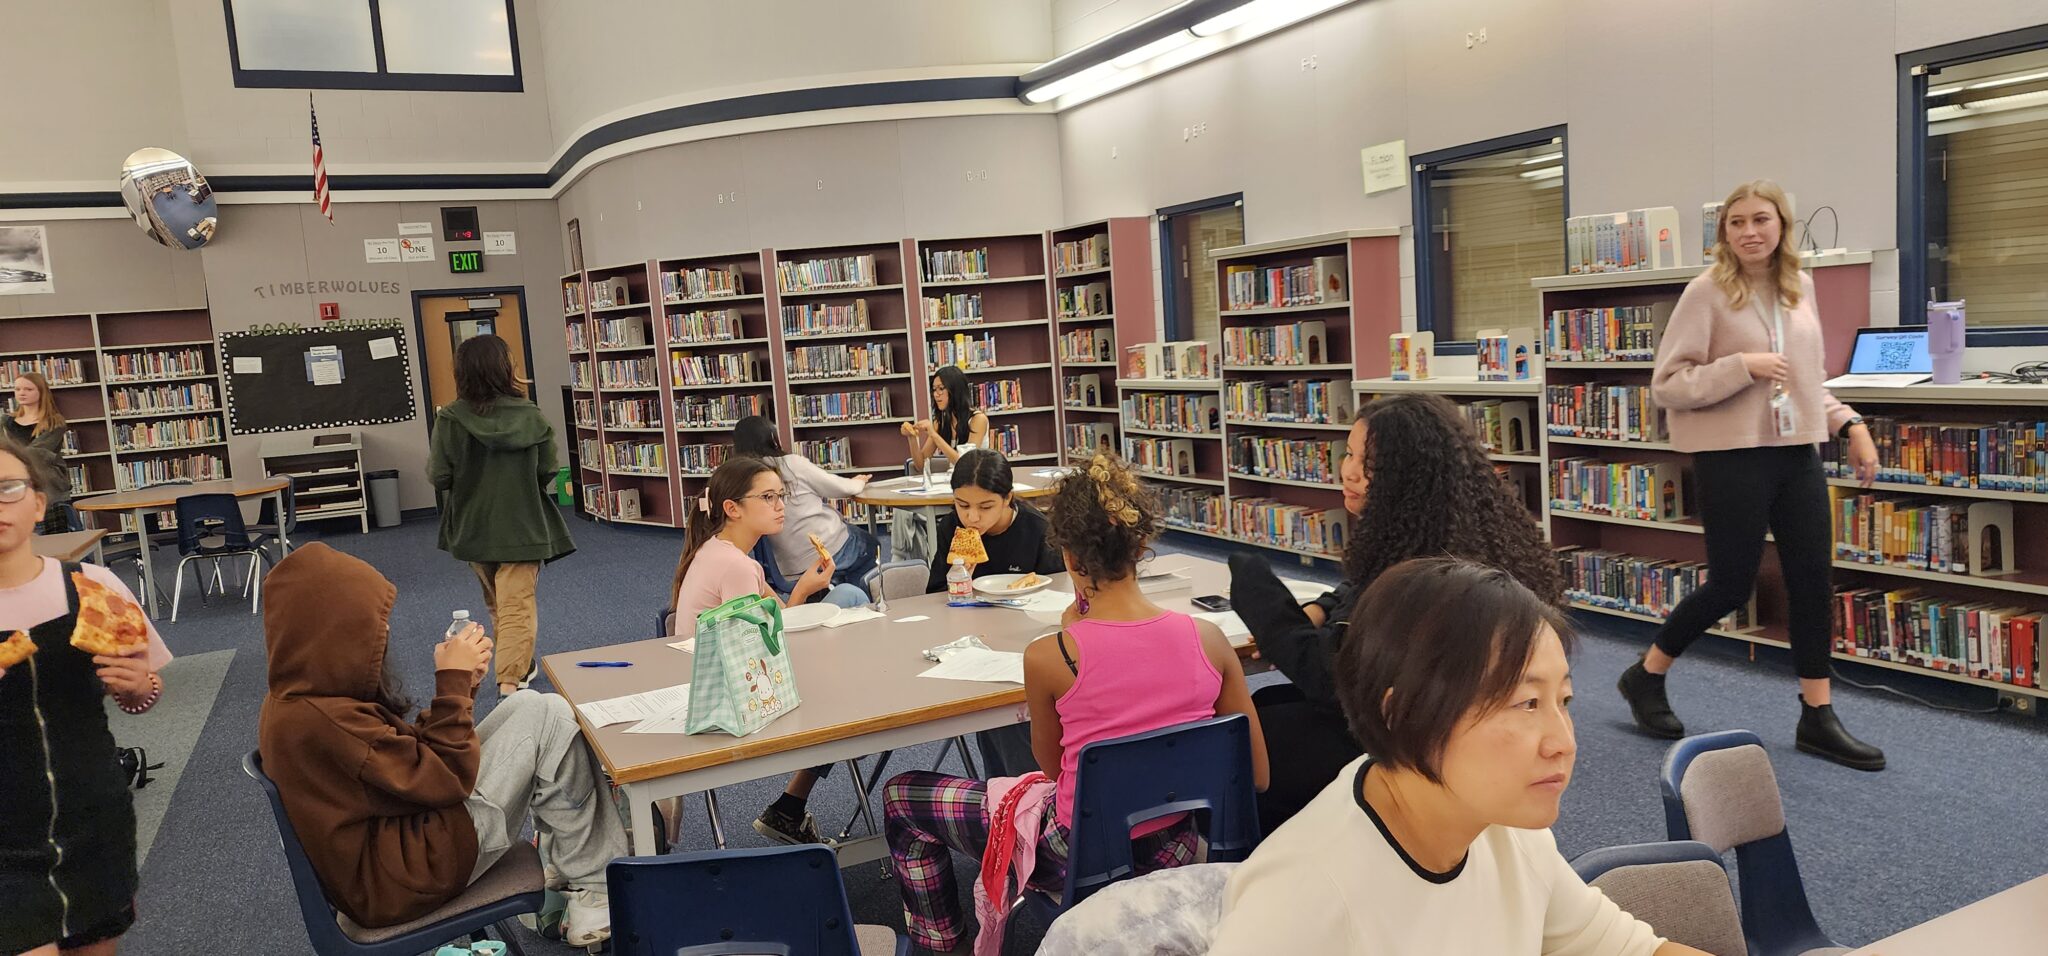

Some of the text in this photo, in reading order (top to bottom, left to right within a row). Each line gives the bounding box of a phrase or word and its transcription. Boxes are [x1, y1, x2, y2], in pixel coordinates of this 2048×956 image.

[408, 245, 427, 254] ONE
[495, 239, 505, 247] 10
[452, 252, 478, 271] EXIT
[254, 280, 400, 299] TIMBERWOLVES
[250, 322, 301, 337] BOOK
